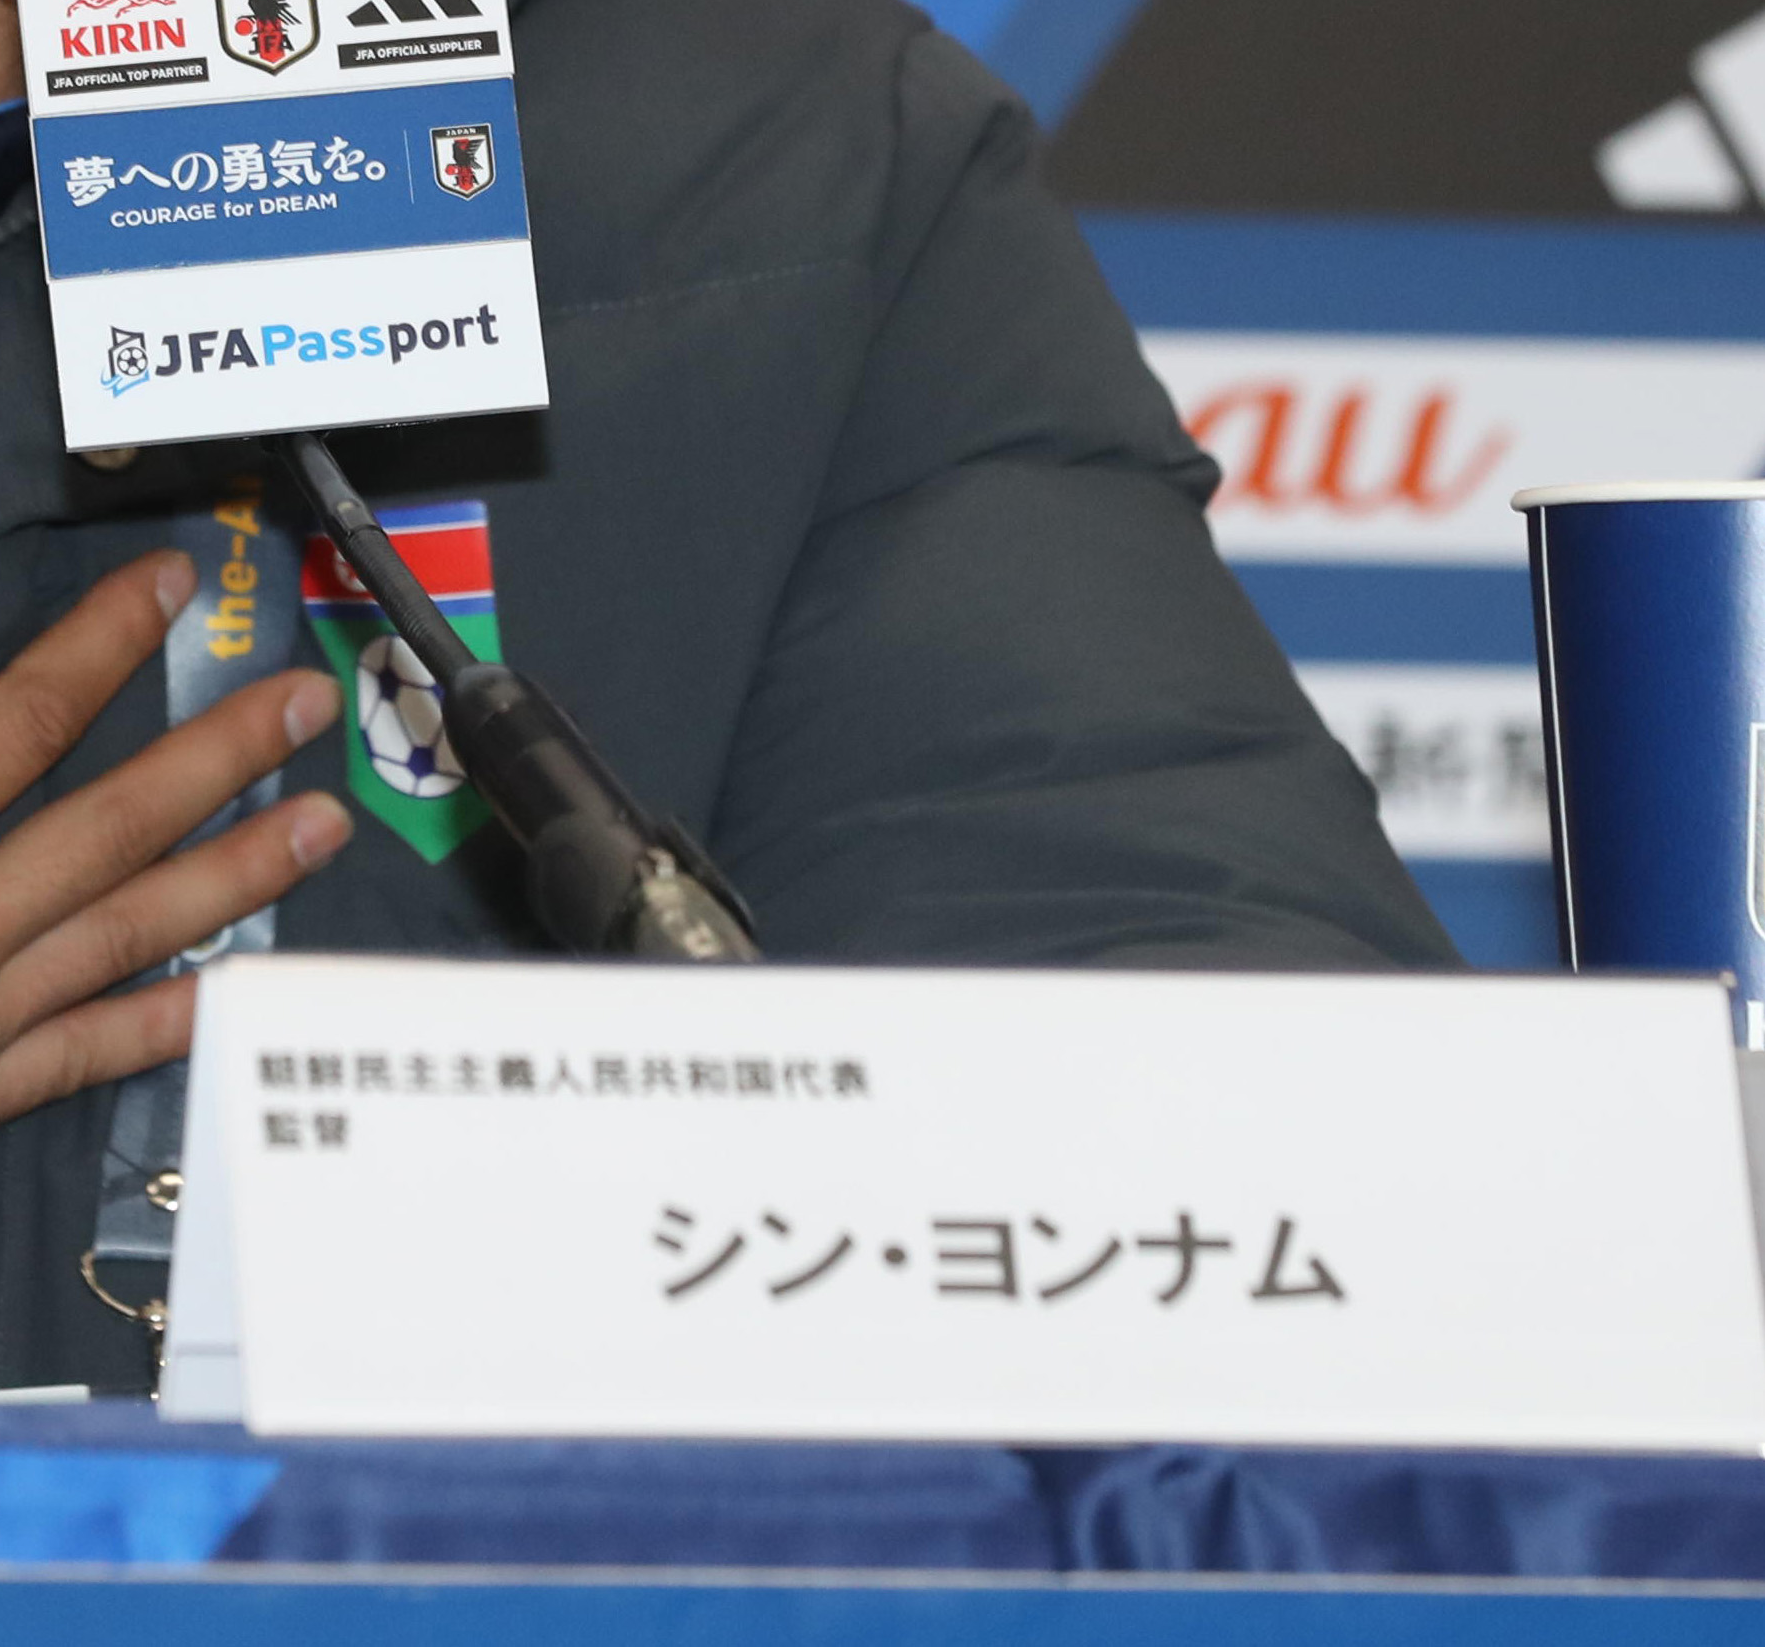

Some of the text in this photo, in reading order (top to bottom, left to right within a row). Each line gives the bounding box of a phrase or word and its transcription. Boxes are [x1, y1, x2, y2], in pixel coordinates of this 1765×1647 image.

[60, 18, 186, 59] KIRIN
[248, 34, 295, 55] JFA
[356, 39, 482, 61] JFA OFFICIAL SUPPLIER
[53, 65, 203, 89] JFA OFFICIAL TOP PARTNER
[446, 128, 476, 136] JAPAN
[63, 136, 387, 207] 夢への勇気を。
[110, 193, 338, 228] COURAGE for DREAM
[1182, 380, 1515, 516] au
[258, 1052, 869, 1098] 朝鮮民主主義人民共和国代表
[262, 1110, 349, 1149] 監督
[654, 1206, 1345, 1304] シン・ヨンナム
